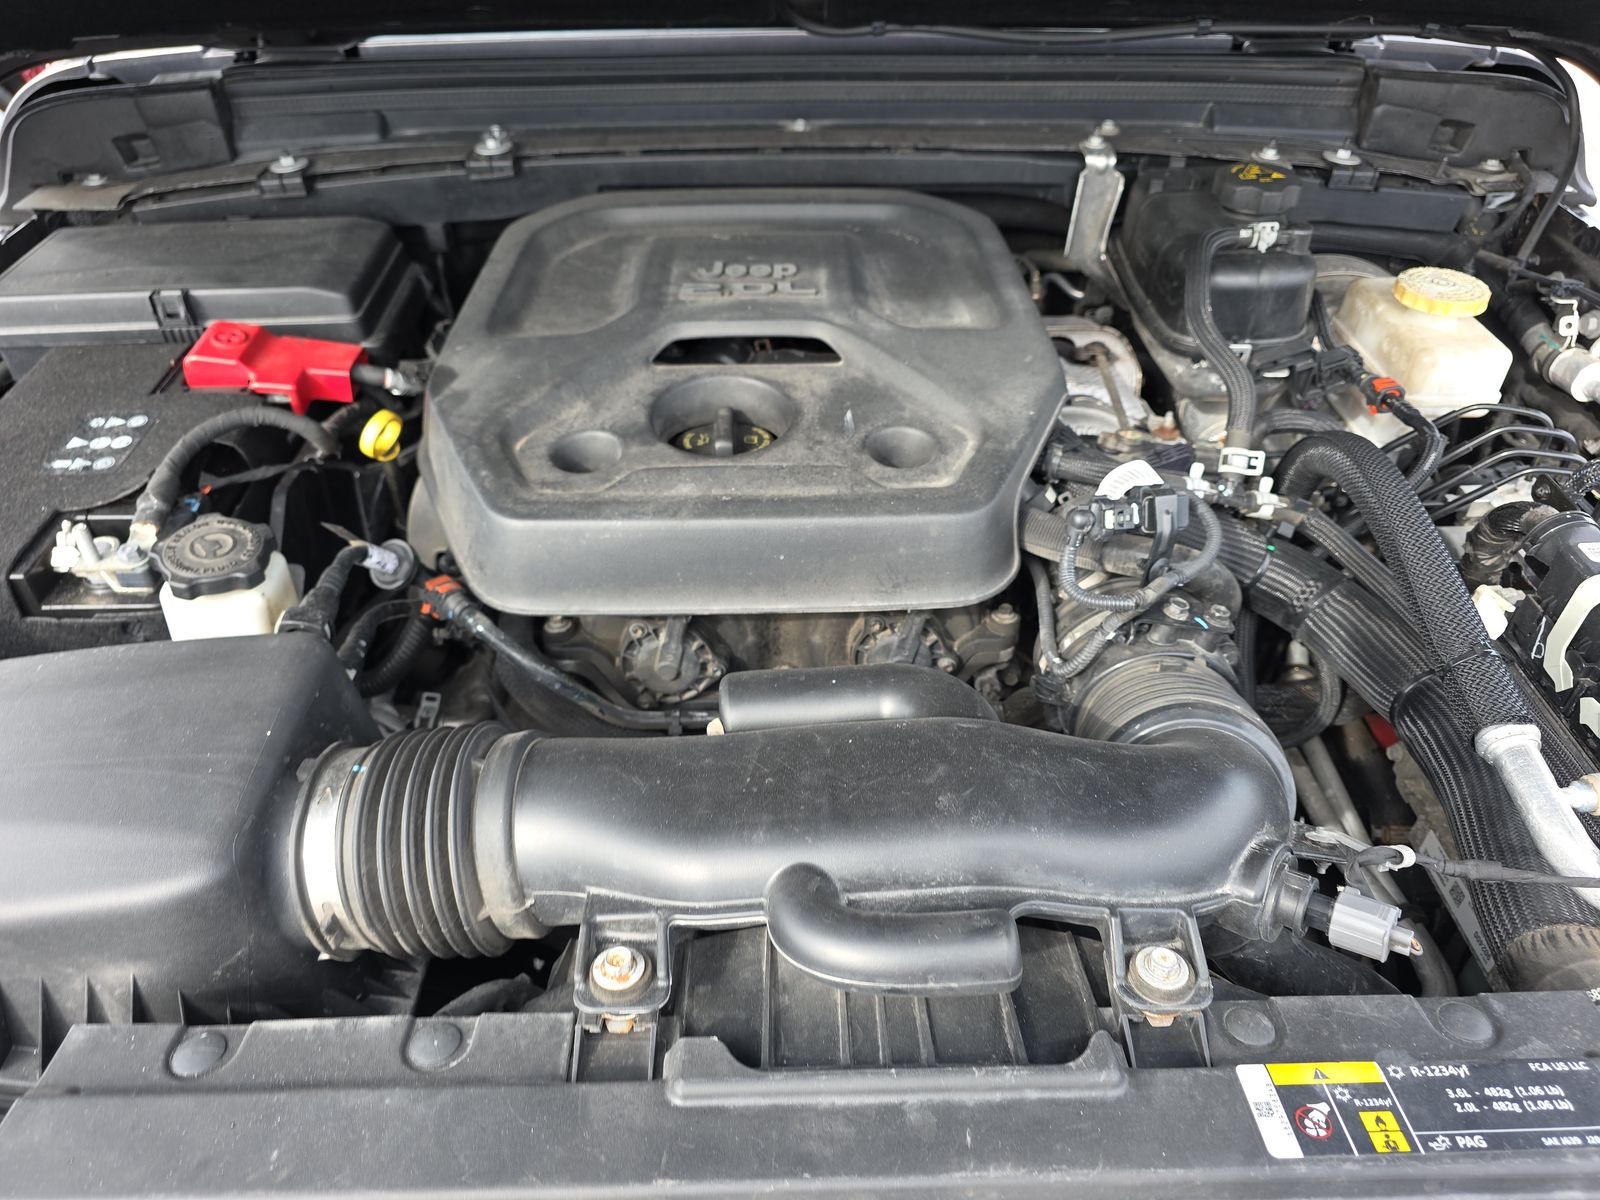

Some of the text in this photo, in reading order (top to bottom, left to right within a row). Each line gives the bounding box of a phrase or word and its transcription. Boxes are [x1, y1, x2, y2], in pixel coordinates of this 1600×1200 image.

[697, 260, 798, 279] Jeep
[1409, 1065, 1471, 1079] R-1234yf
[1528, 1061, 1590, 1072] FCA US LLC
[1445, 1088, 1472, 1099] 3.6L
[1484, 1086, 1513, 1099] 482g
[1514, 1085, 1544, 1098] (1.06
[1544, 1085, 1566, 1097] Lb)
[1354, 1098, 1392, 1109] R-1234yf
[1453, 1102, 1480, 1113] 2.0L
[1492, 1101, 1522, 1113] 482g
[1523, 1100, 1553, 1113] (1.06
[1553, 1099, 1575, 1111] Lb)
[1455, 1135, 1488, 1149] PAG
[1541, 1136, 1560, 1146] SAE
